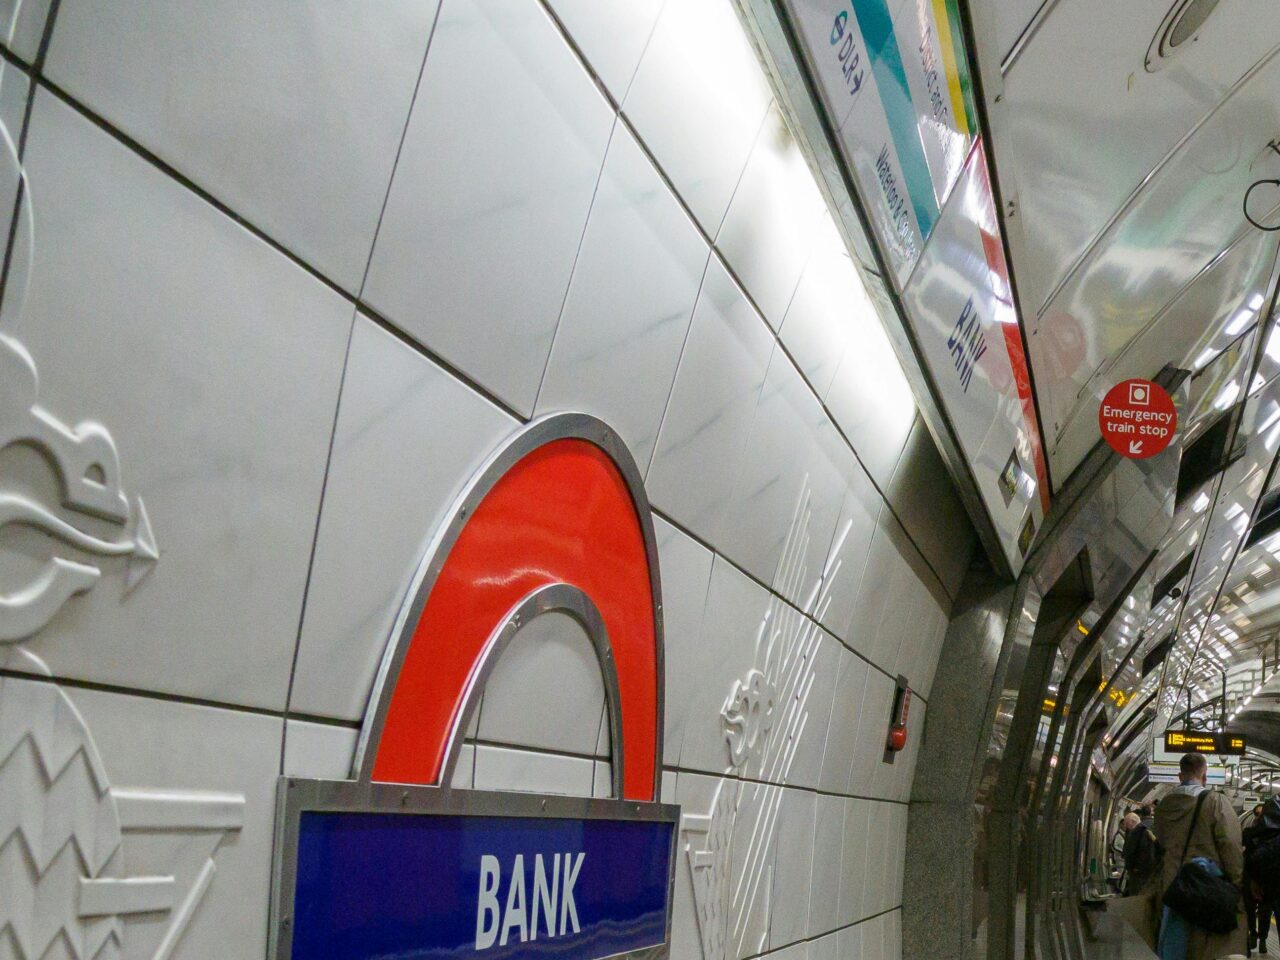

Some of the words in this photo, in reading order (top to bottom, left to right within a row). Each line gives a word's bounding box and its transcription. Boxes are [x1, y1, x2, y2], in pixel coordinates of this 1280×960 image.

[838, 32, 860, 85] DLR
[875, 143, 899, 210] Waterloo
[947, 294, 987, 393] BANK
[1103, 405, 1172, 424] Emergency
[1107, 421, 1135, 433] train
[1140, 424, 1168, 438] stop
[475, 852, 586, 950] BANK
